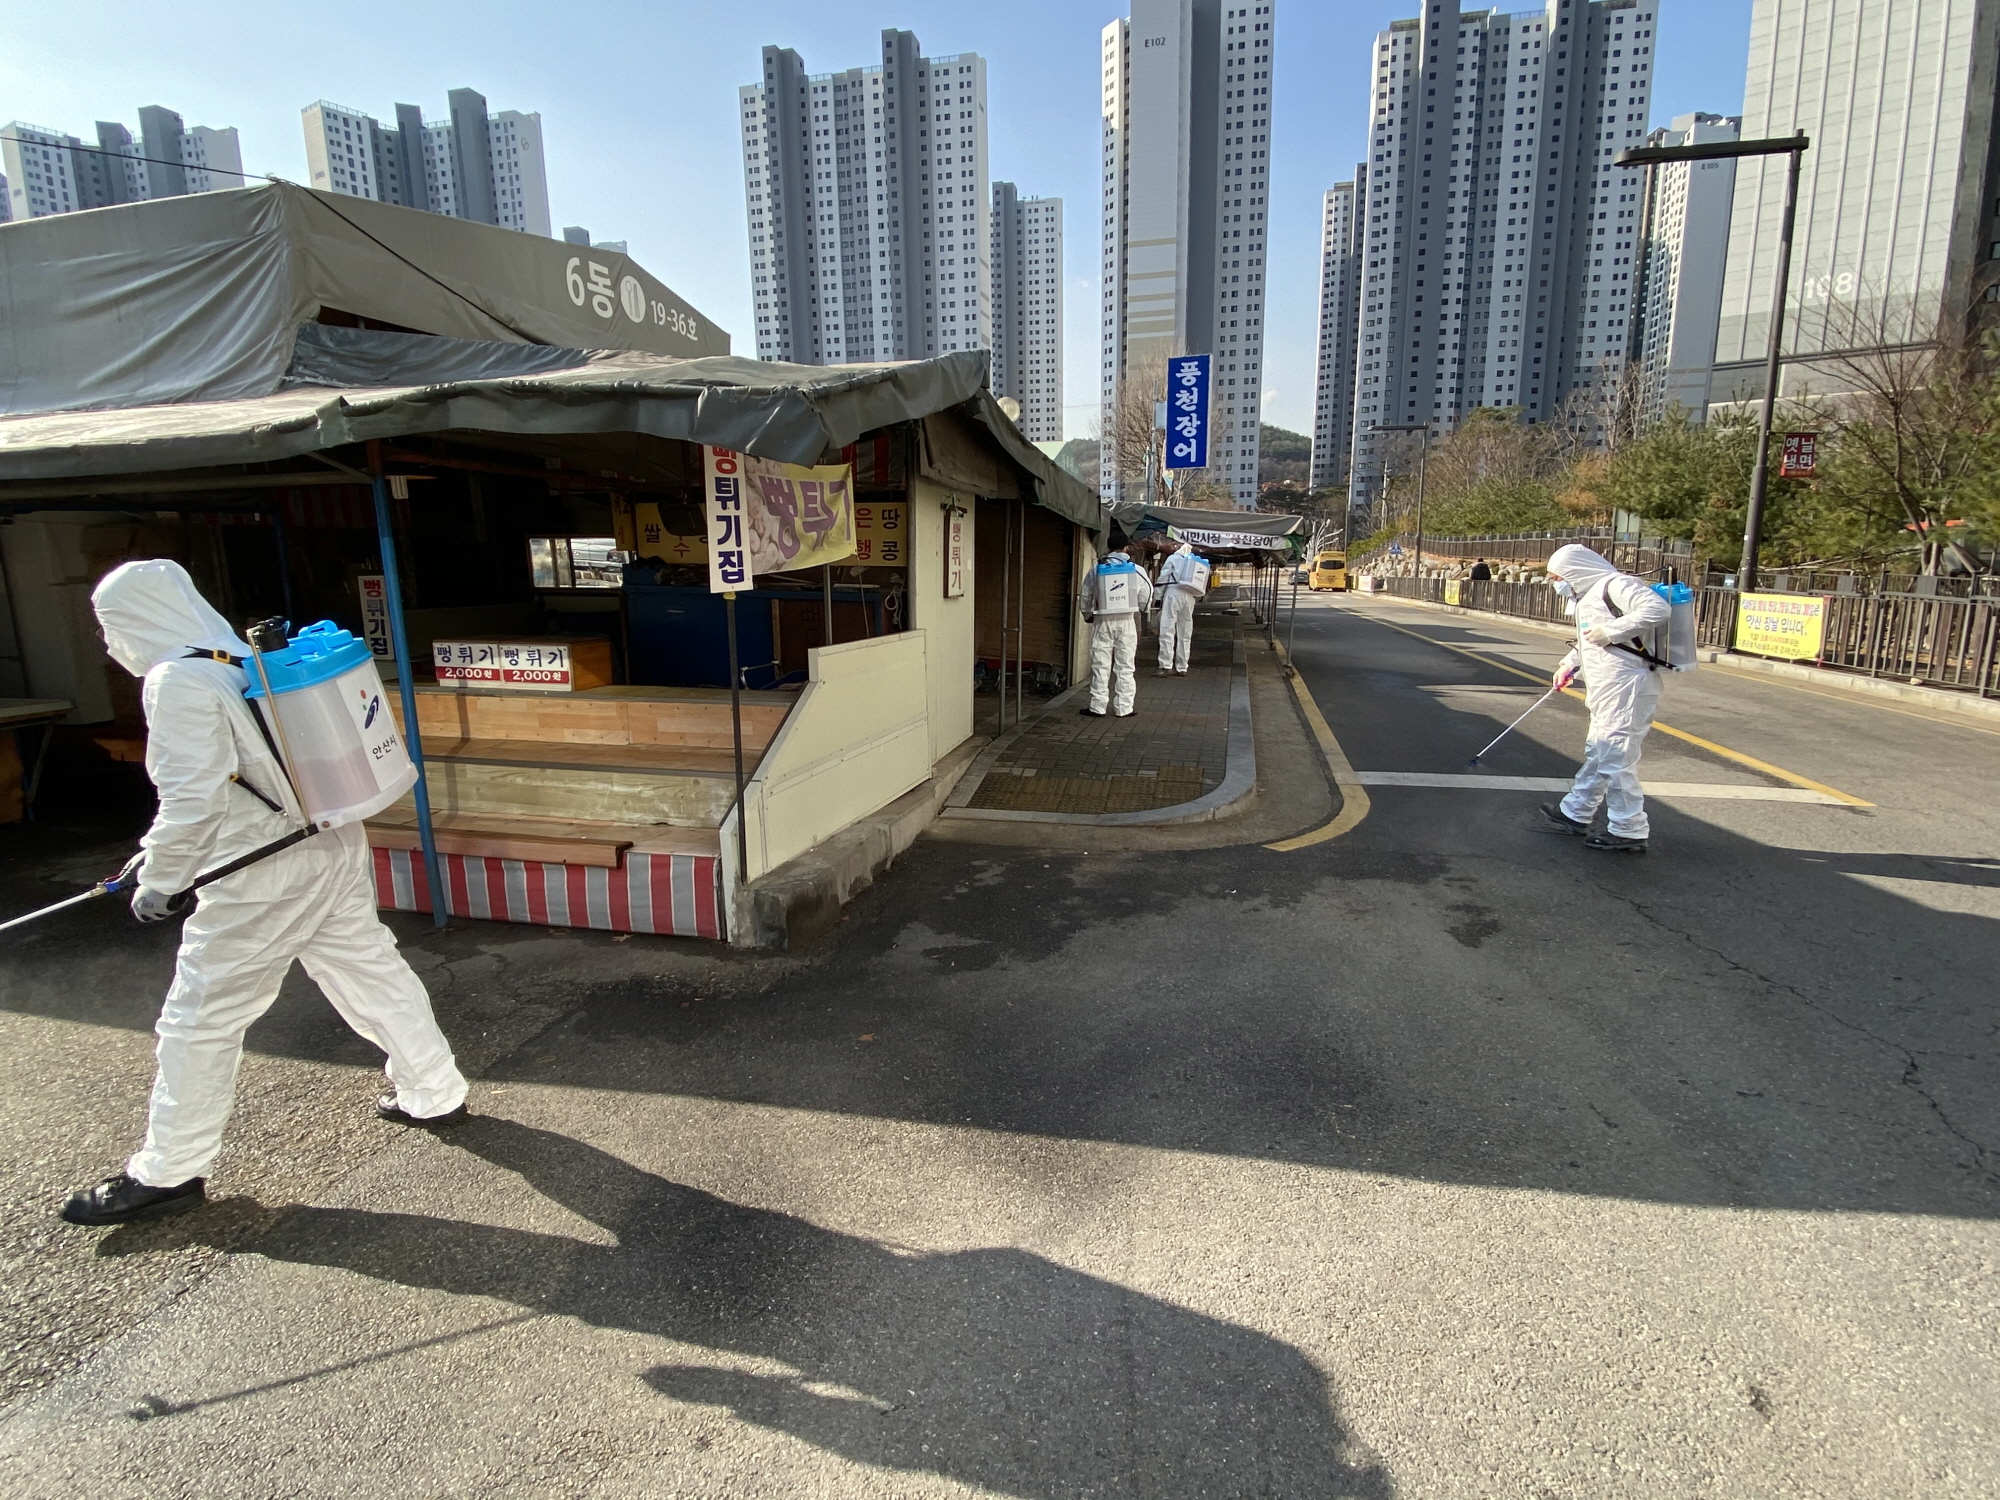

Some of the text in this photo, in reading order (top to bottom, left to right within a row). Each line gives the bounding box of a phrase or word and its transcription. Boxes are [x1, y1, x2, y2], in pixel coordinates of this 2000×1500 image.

[1144, 36, 1166, 48] E102
[1804, 271, 1853, 299] 108
[566, 256, 699, 341] 6동 19-36호
[1173, 360, 1202, 463] 풍천장어
[1785, 436, 1815, 453] 옛날
[1783, 454, 1813, 470] 냉면
[757, 475, 852, 560] 뻥튀기
[643, 523, 662, 544] 쌀
[881, 507, 901, 562] 땅콩
[1180, 531, 1221, 545] 시민시장
[951, 522, 962, 590] 뻥튀기
[1745, 614, 1763, 630] 안산
[1764, 616, 1780, 632] 장날
[436, 645, 564, 668] 뻥튀기 뻥튀기
[445, 668, 562, 682] 2,000원 2,000원
[372, 734, 398, 760] 안산시
